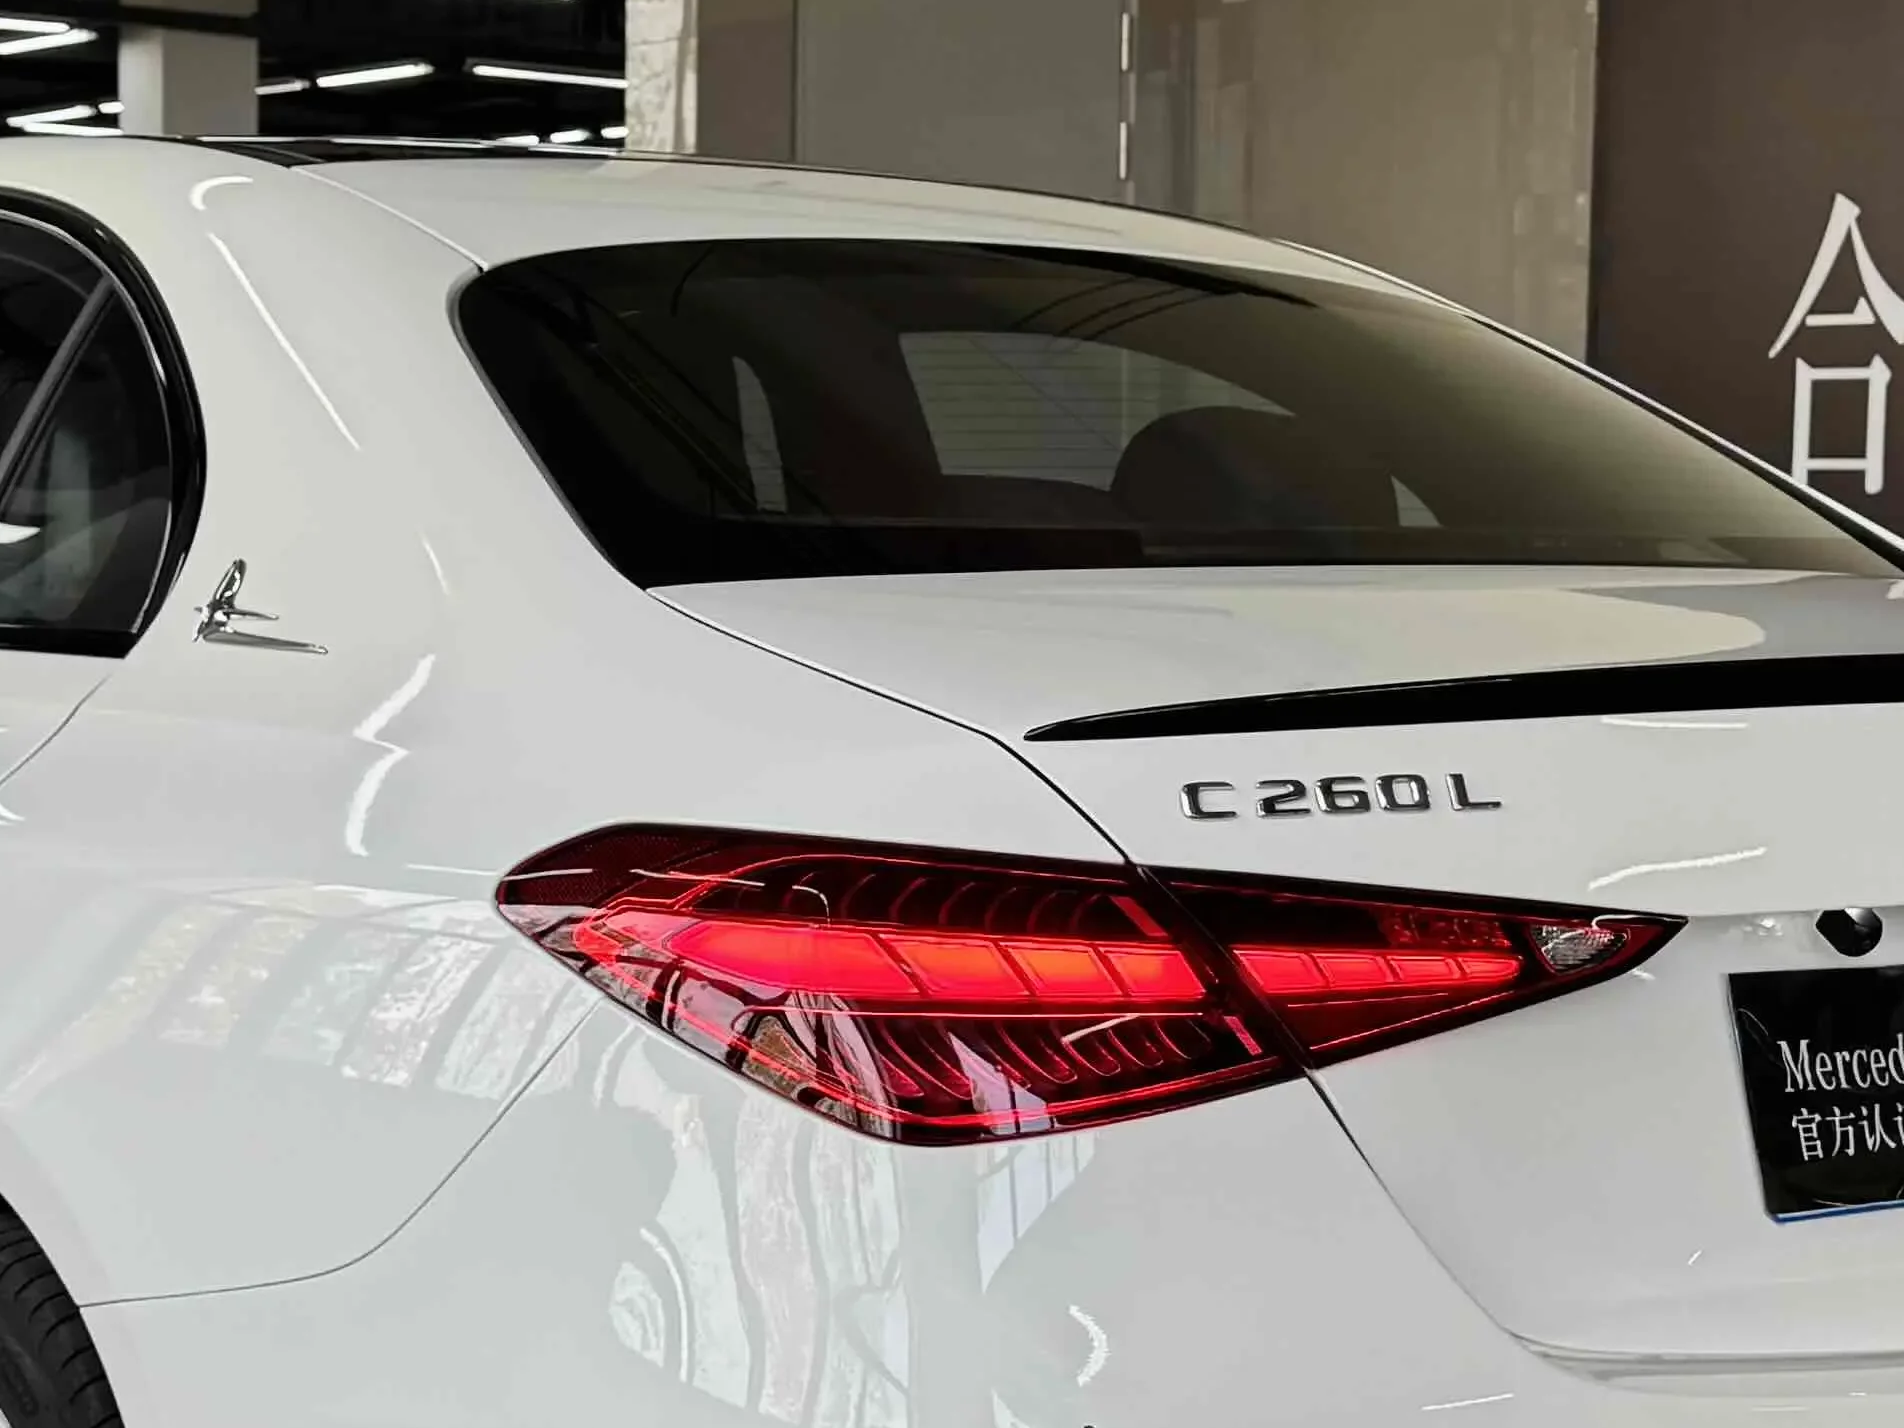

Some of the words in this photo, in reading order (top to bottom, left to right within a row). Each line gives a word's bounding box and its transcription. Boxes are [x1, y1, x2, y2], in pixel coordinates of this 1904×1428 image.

[1180, 780, 1238, 820] C
[1256, 773, 1433, 819] 260
[1446, 772, 1503, 812] L
